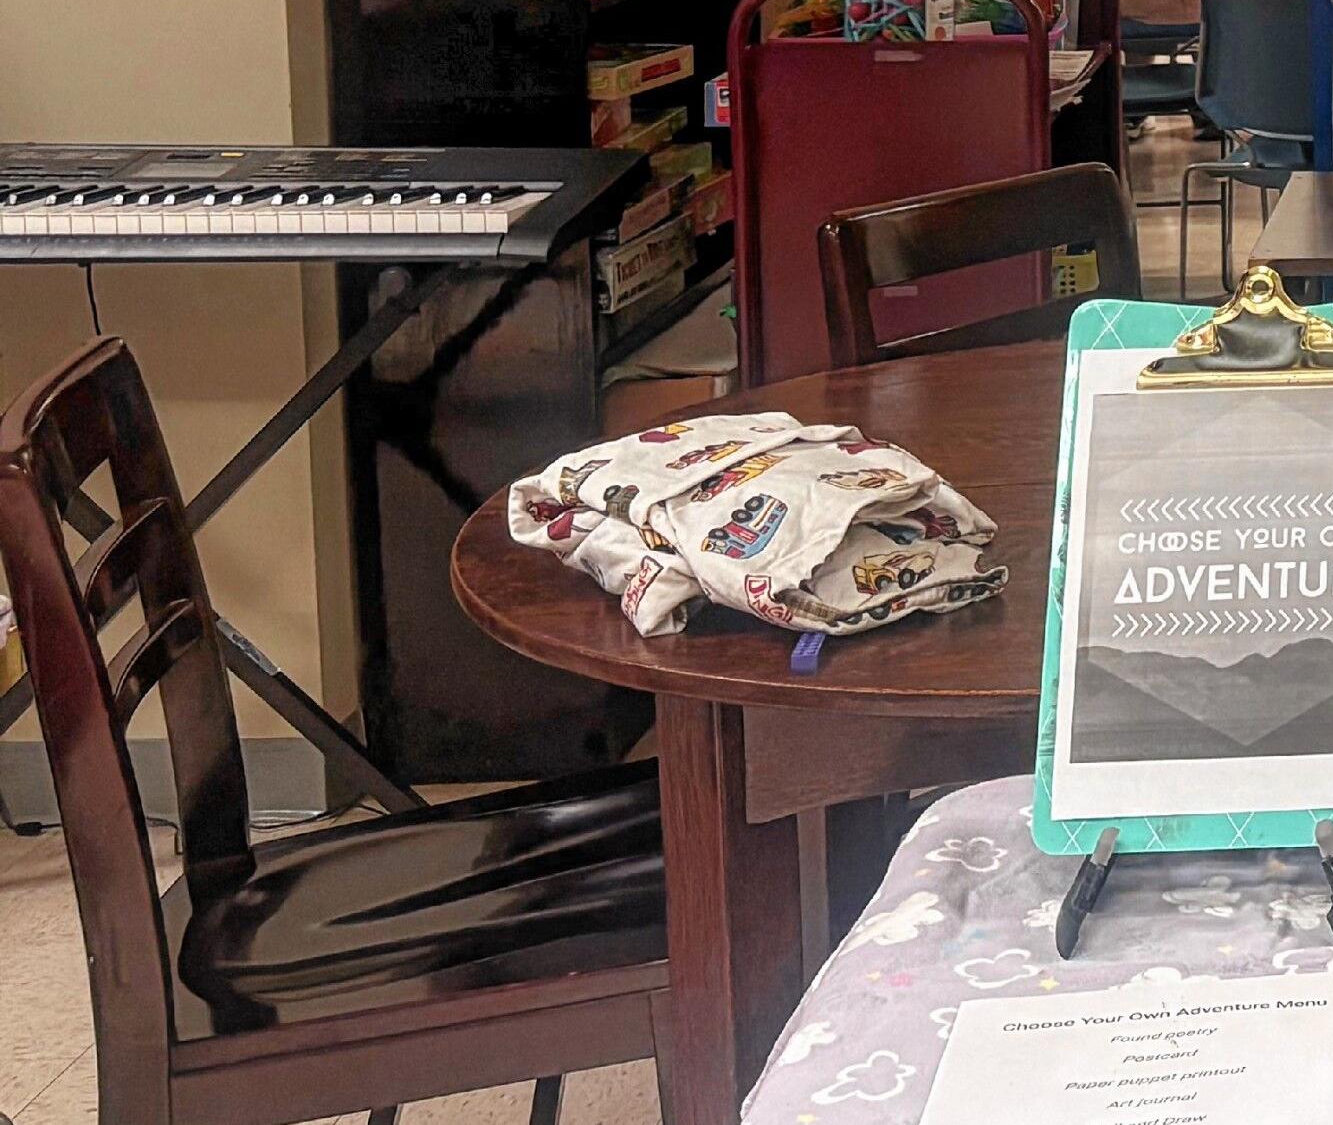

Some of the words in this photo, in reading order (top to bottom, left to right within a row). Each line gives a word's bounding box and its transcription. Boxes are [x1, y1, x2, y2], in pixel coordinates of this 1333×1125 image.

[1118, 530, 1222, 554] CHOOSE
[1235, 528, 1306, 550] YOUR
[1003, 1021, 1075, 1032] Choose
[1082, 1016, 1124, 1025] Your
[1129, 1010, 1171, 1021] Own
[1176, 1002, 1271, 1017] Adventure
[1276, 999, 1328, 1009] Menu
[1110, 1032, 1162, 1043] Found
[1165, 1027, 1218, 1040] poetry
[1122, 1049, 1199, 1063] Postcard
[1064, 1080, 1115, 1091] Paper
[1117, 1073, 1177, 1088] puppet
[1180, 1067, 1247, 1081] printout
[1106, 1099, 1134, 1109] Art
